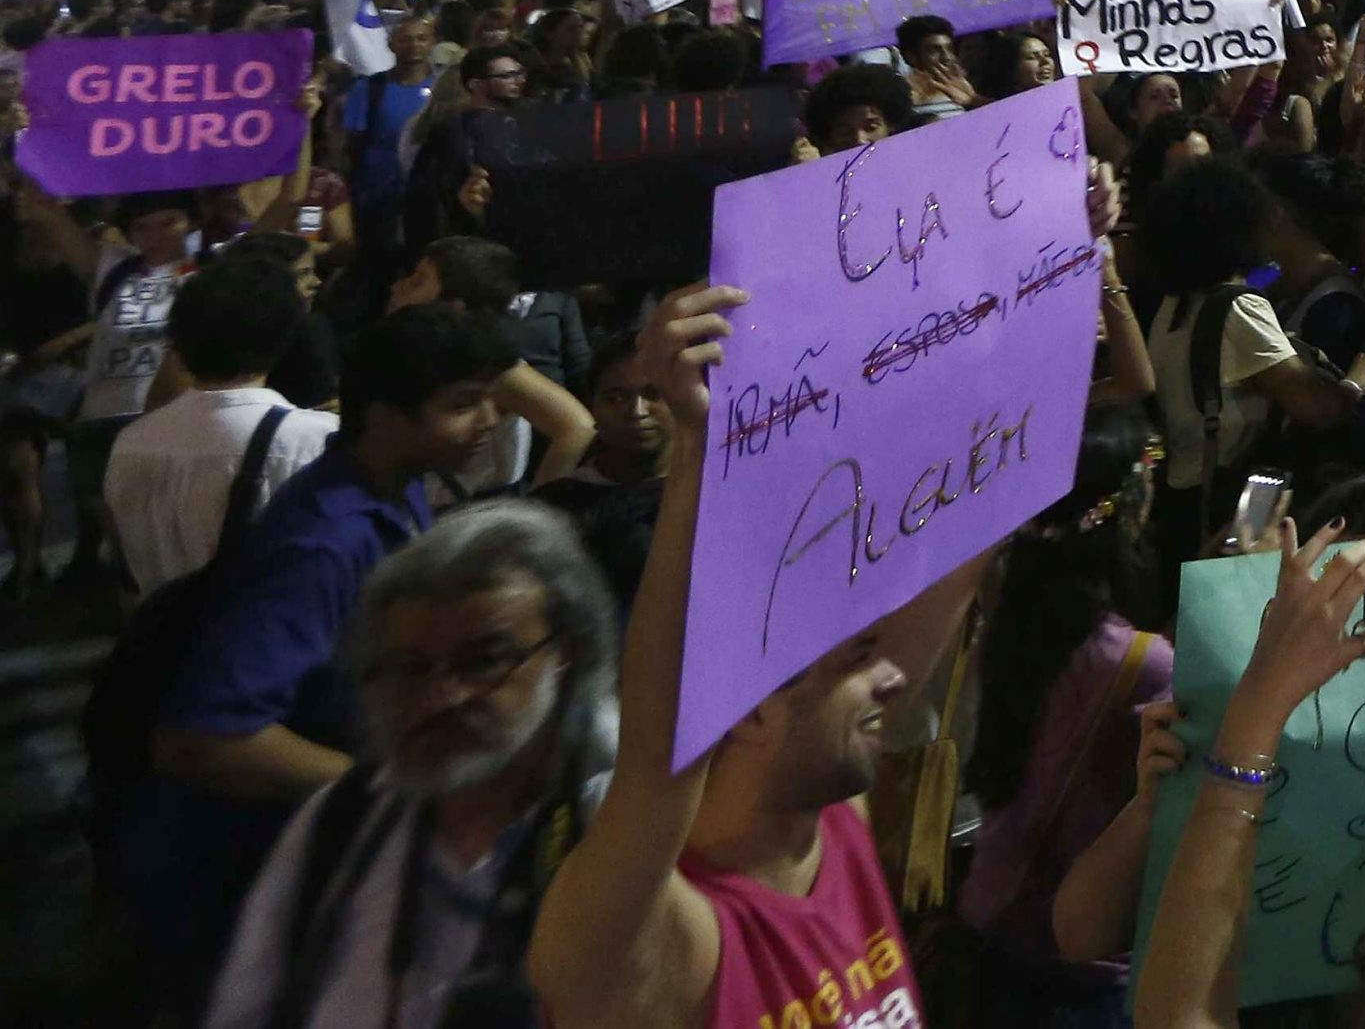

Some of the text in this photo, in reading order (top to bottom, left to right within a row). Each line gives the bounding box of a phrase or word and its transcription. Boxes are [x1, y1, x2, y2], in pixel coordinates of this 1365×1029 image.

[1113, 24, 1278, 69] Regras
[68, 61, 275, 103] GRELO
[89, 108, 273, 157] DURO
